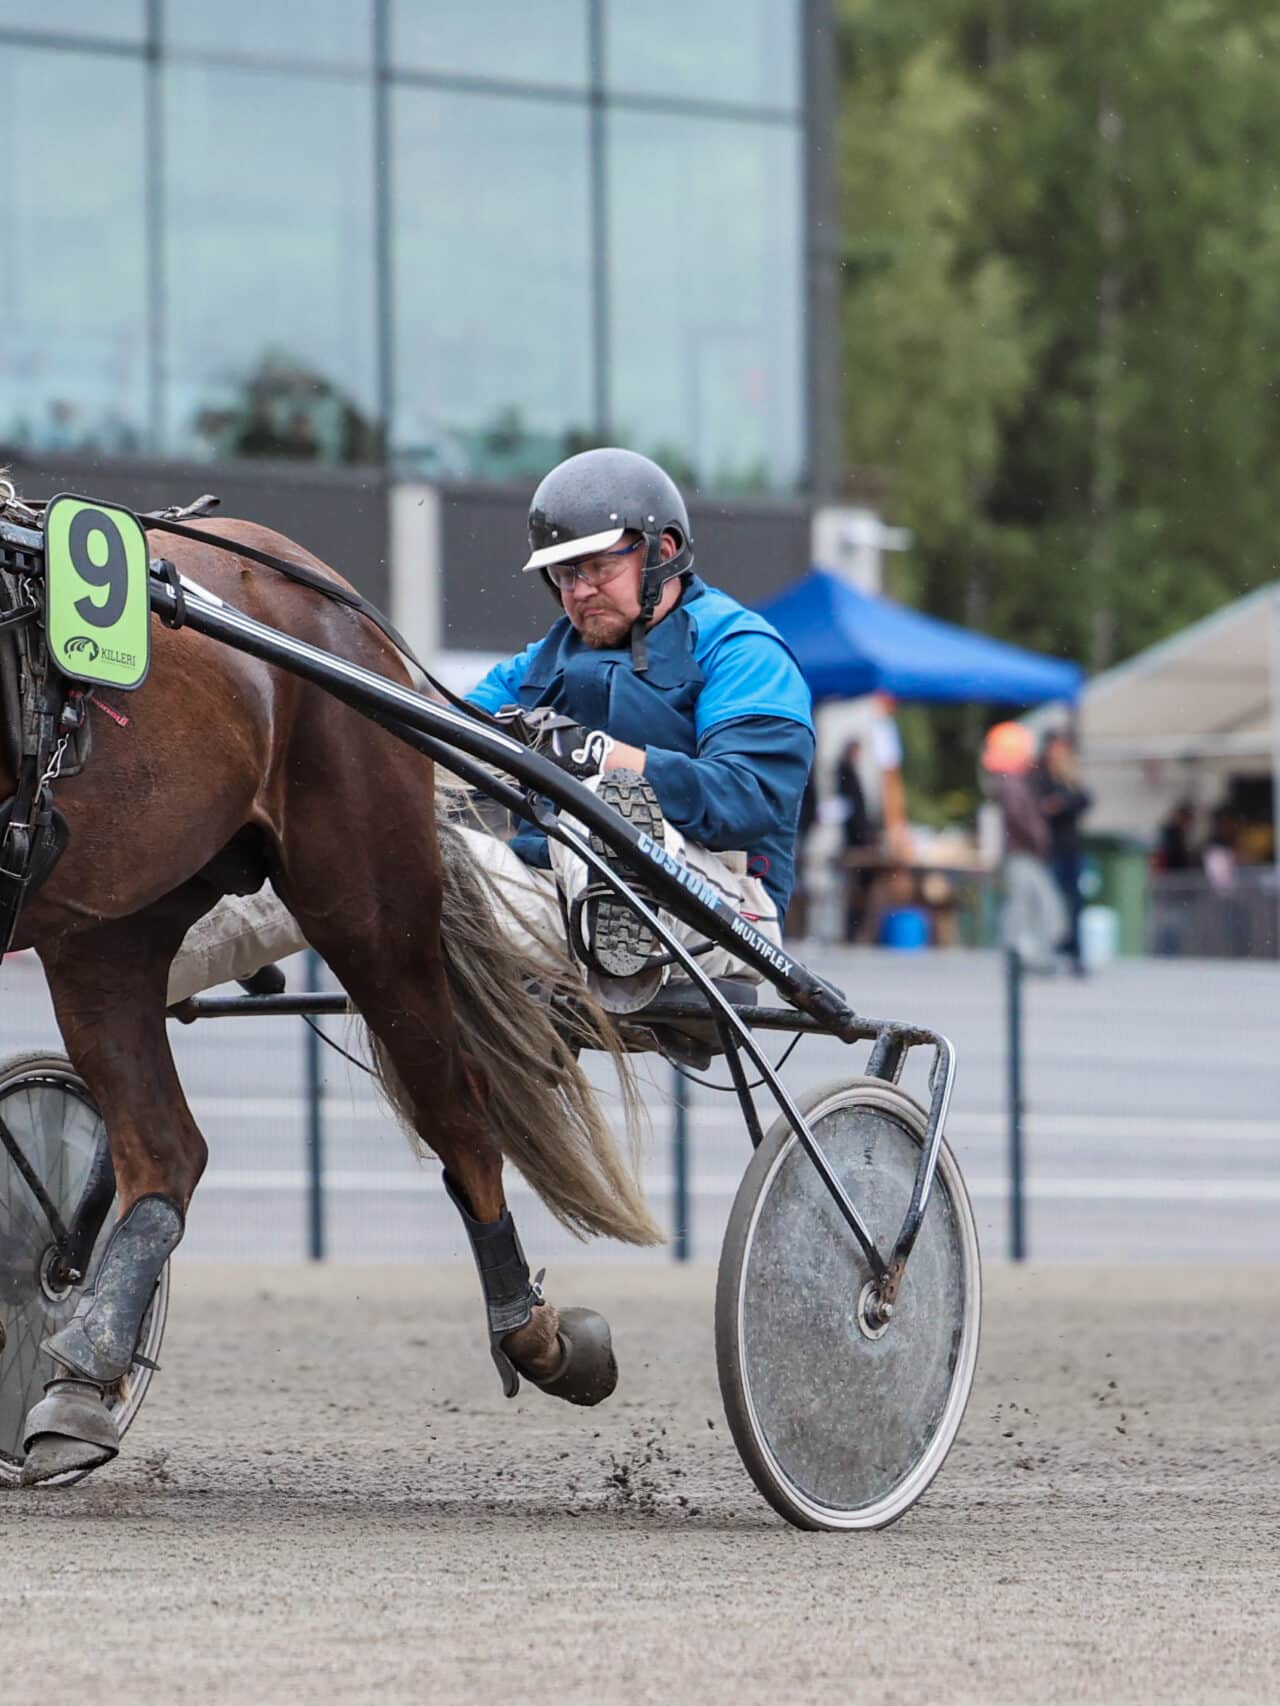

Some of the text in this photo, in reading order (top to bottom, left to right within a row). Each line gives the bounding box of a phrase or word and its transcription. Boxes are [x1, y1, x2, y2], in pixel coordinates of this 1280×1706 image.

[69, 508, 129, 628] 9
[101, 647, 137, 667] KILLERI
[731, 917, 793, 977] MULTIFLEX
